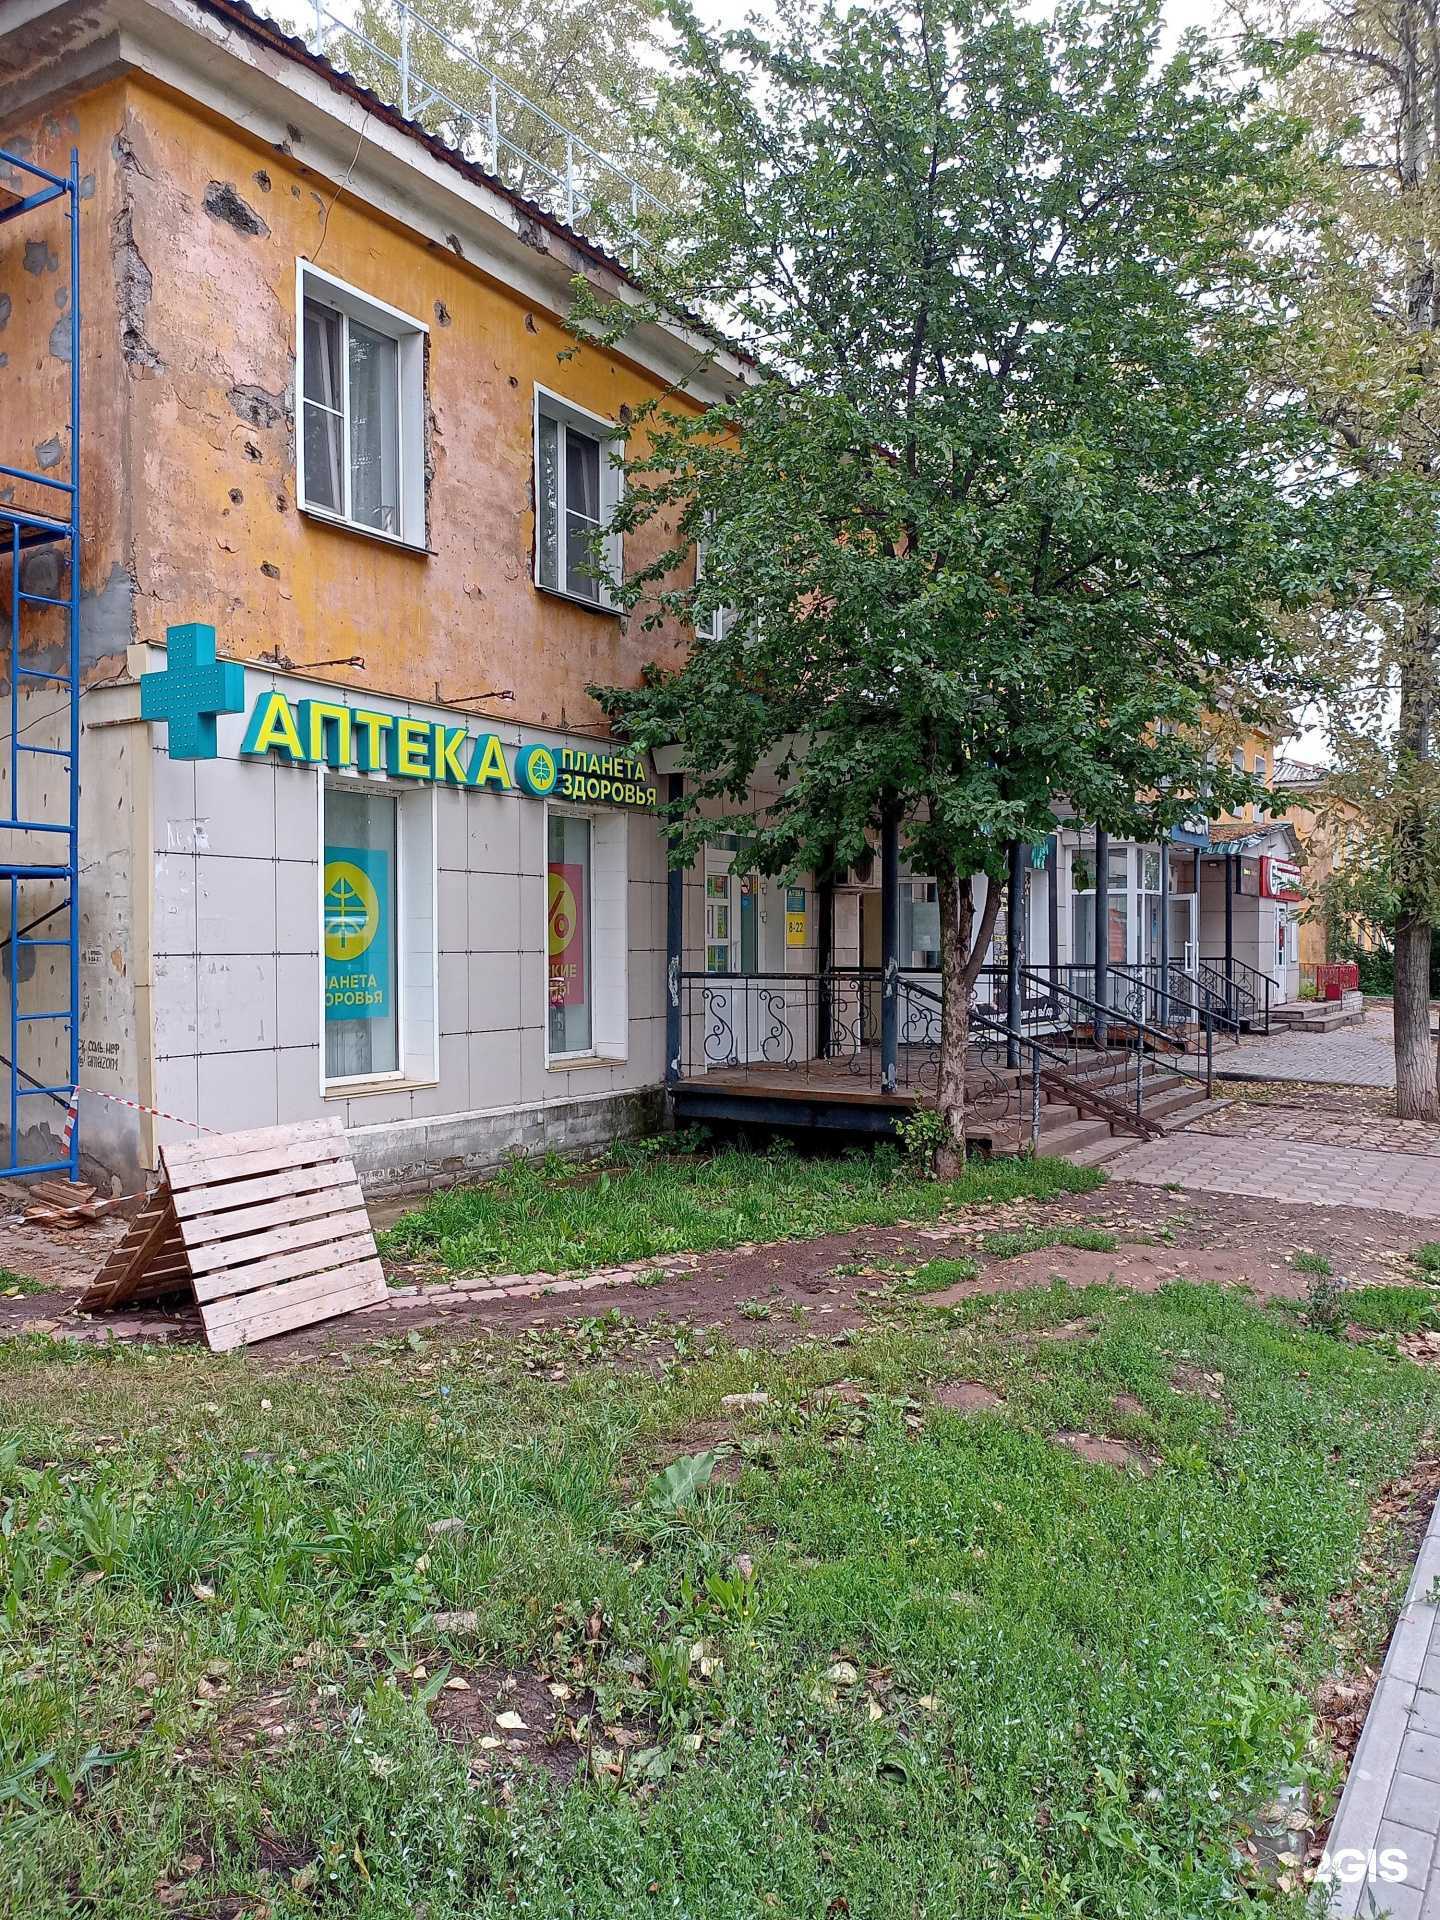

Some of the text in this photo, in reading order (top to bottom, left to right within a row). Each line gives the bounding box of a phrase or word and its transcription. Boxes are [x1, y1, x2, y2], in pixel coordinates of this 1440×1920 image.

[243, 692, 512, 790] АПТЕКА
[562, 748, 646, 781] ПЛАНЕТА
[562, 774, 657, 805] ЗДОРОВЬЯ
[325, 974, 377, 990] АНЕТА
